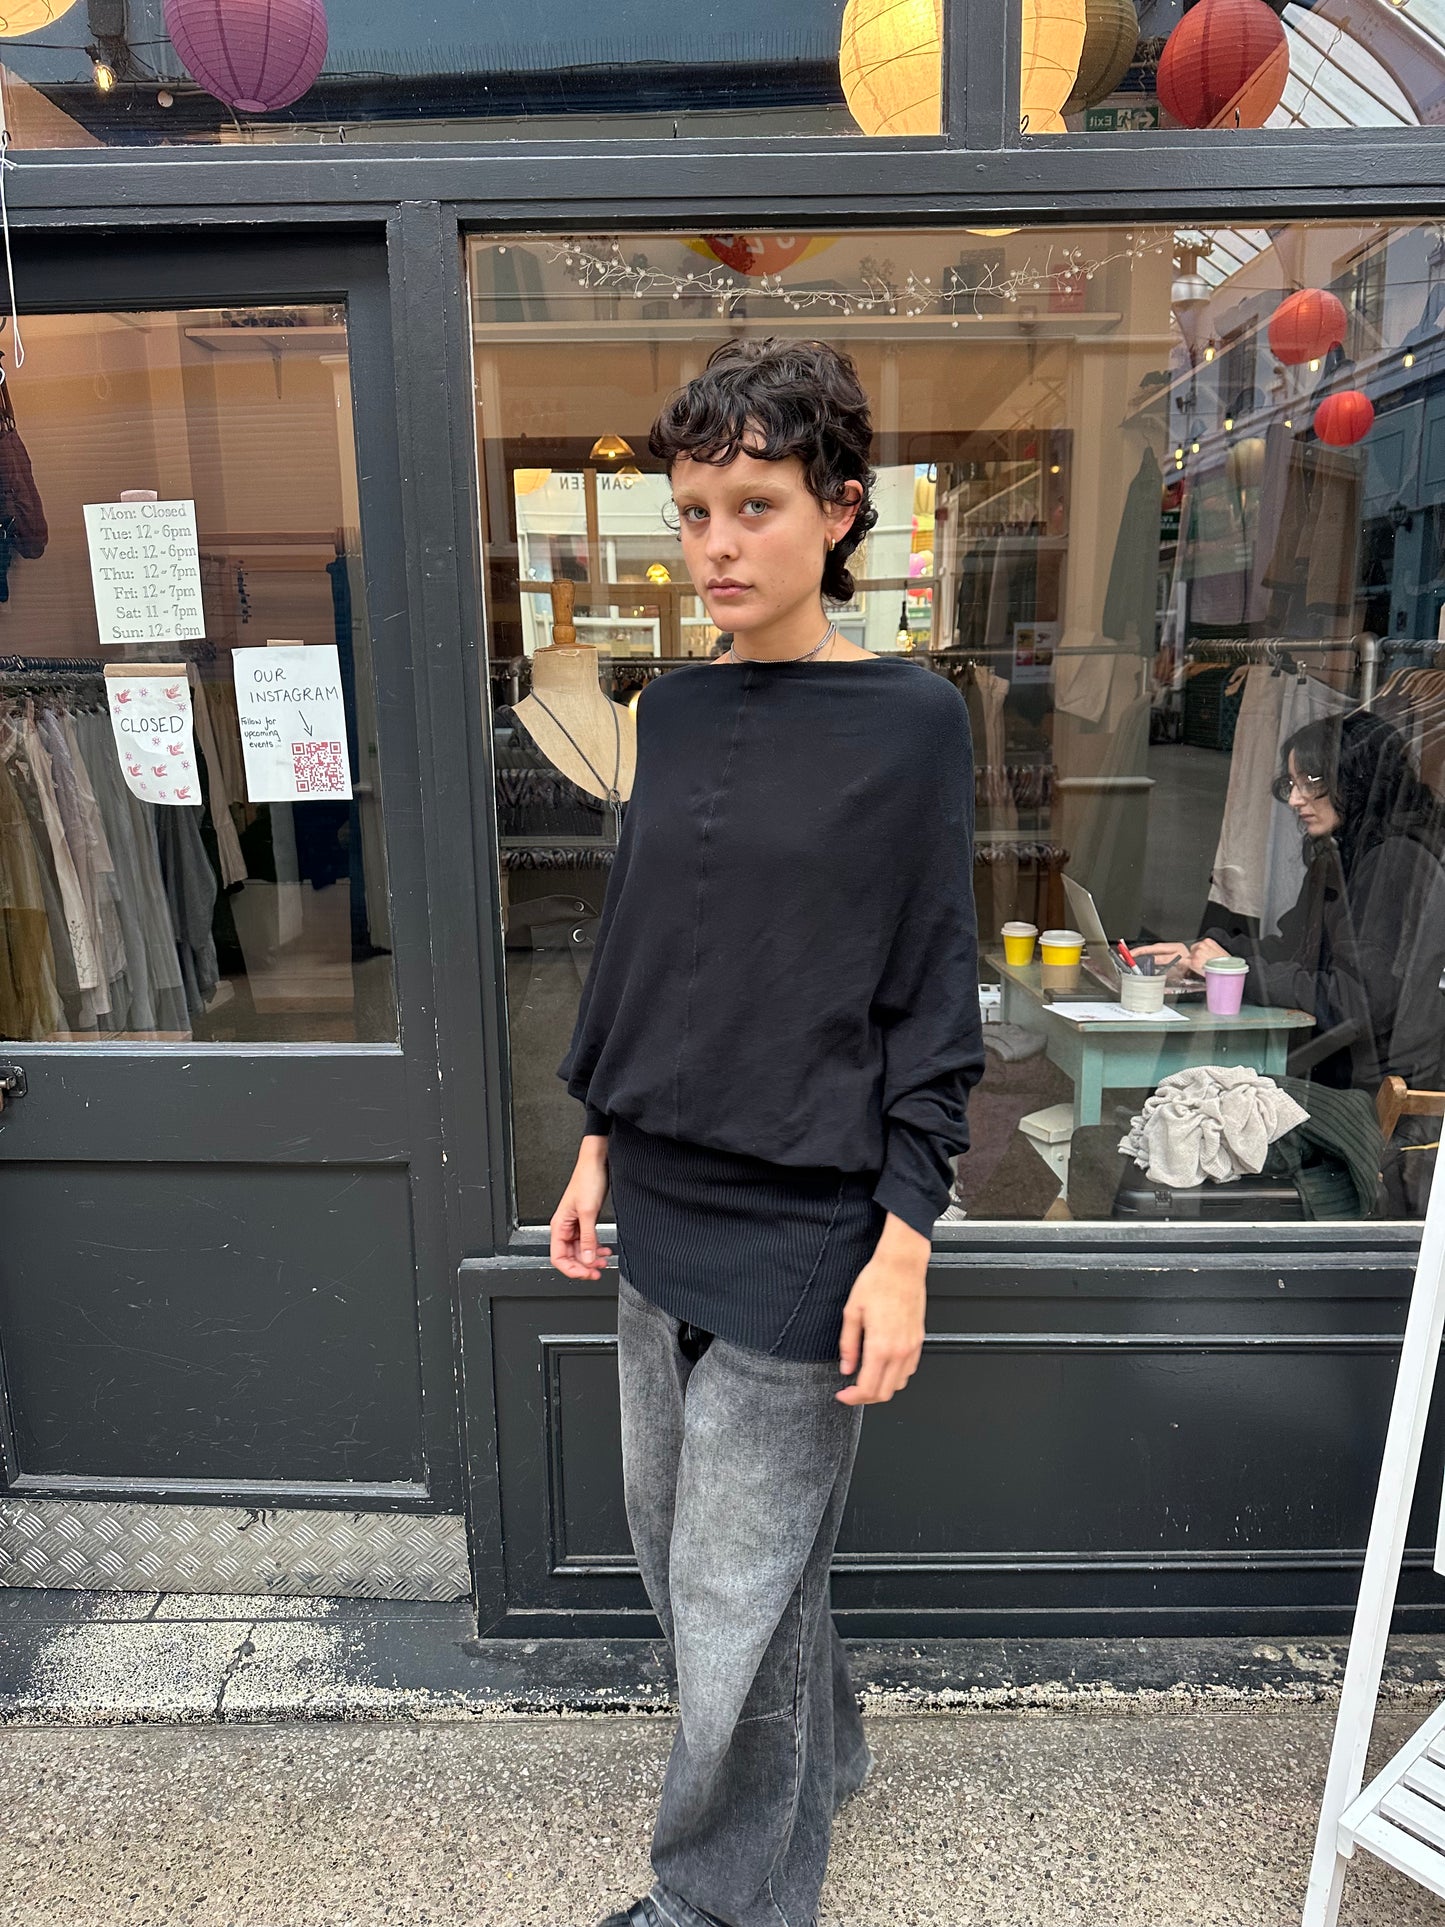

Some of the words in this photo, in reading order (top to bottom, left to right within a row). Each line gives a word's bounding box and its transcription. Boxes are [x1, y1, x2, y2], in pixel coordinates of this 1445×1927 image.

[100, 506, 137, 520] Mon:
[141, 503, 187, 518] Closed
[100, 527, 132, 540] Tue:
[99, 546, 139, 560] Wed:
[99, 567, 135, 580] Thu:
[113, 586, 138, 599] Fri:
[116, 606, 142, 619] Sat:
[111, 625, 144, 638] Sun:
[253, 668, 287, 683] OUR
[249, 685, 340, 704] INSTAGRAM
[120, 715, 184, 734] CLOSED
[240, 716, 262, 726] Follow
[264, 716, 277, 731] for
[244, 730, 282, 743] upcoming
